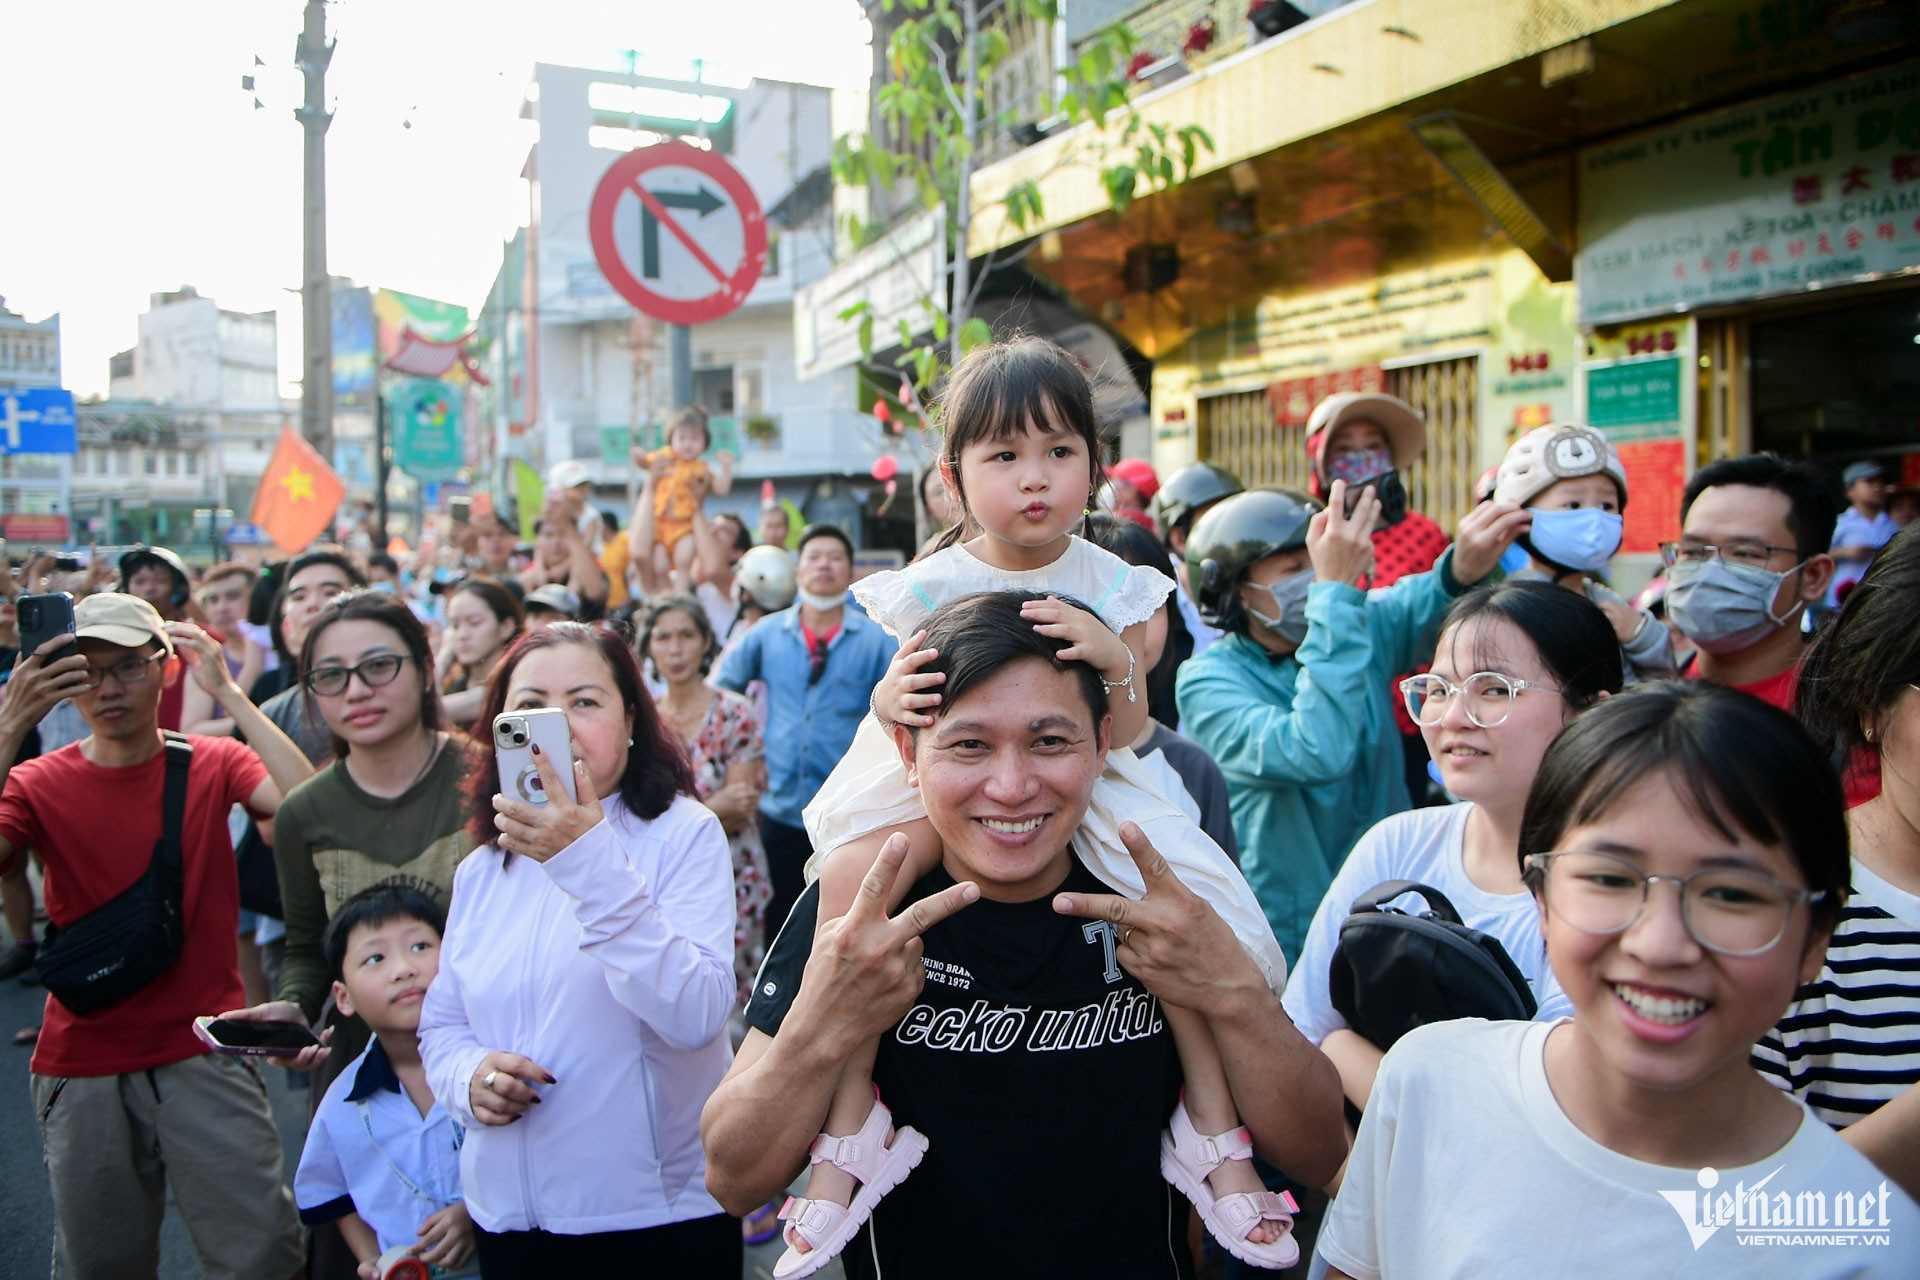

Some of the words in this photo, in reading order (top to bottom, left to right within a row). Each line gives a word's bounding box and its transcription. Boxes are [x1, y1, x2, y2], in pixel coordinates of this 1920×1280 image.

[1734, 121, 1833, 178] TÂN
[945, 963, 975, 981] BRAN
[947, 976, 970, 990] 1972
